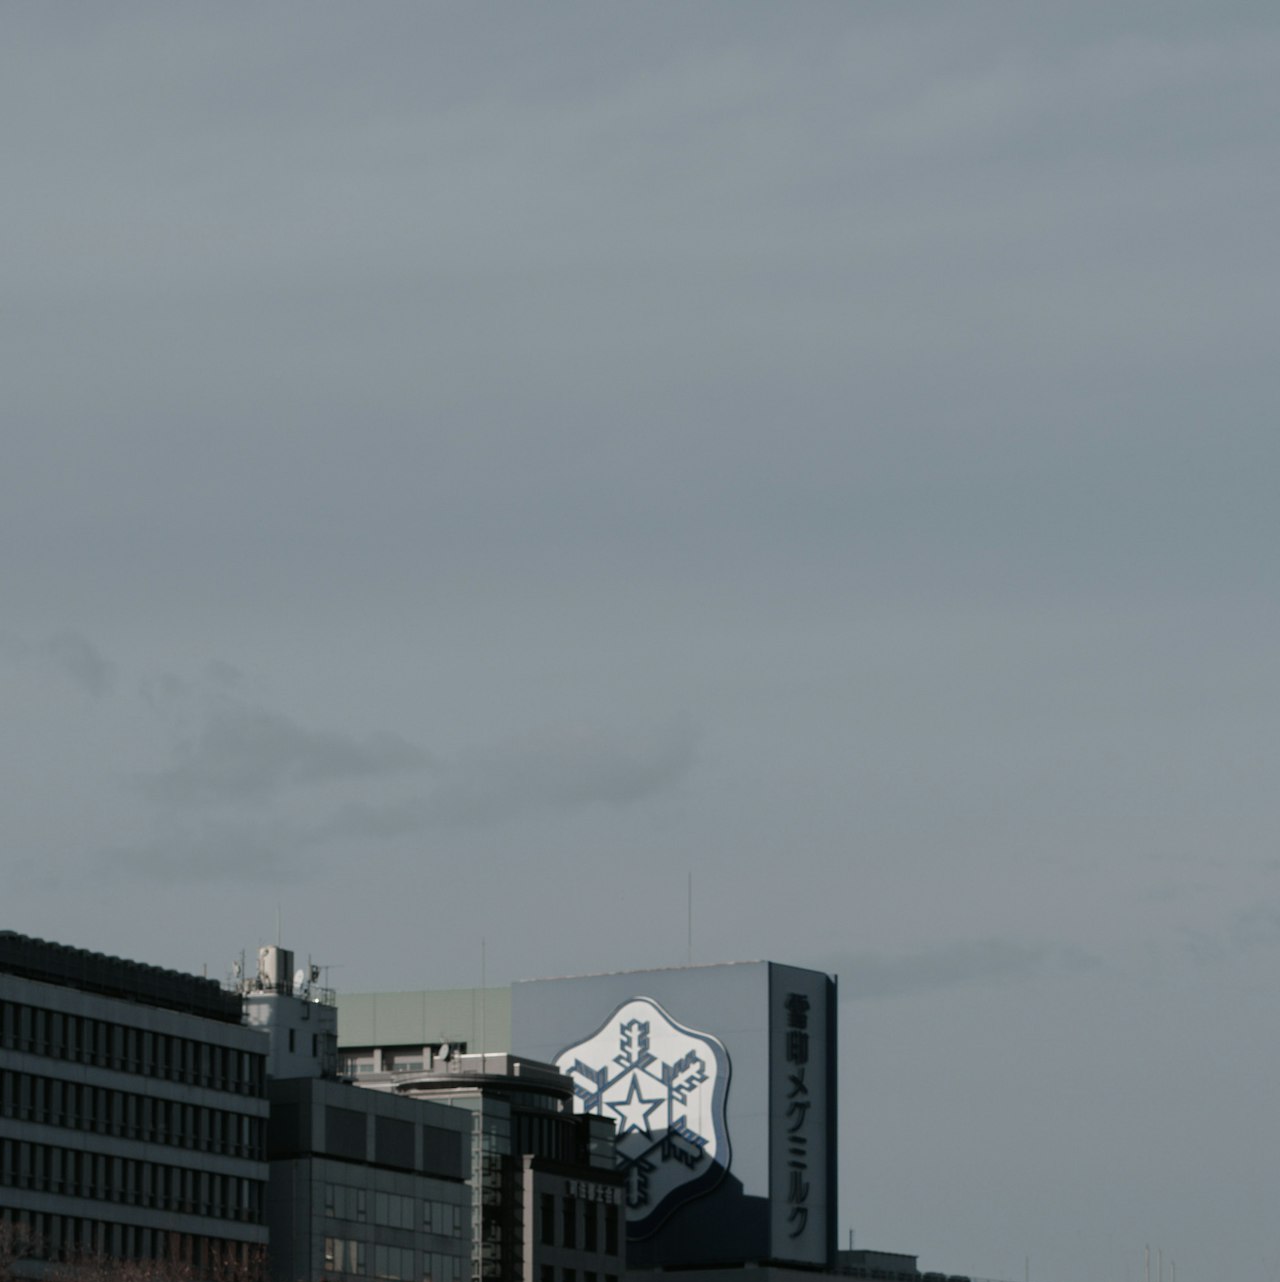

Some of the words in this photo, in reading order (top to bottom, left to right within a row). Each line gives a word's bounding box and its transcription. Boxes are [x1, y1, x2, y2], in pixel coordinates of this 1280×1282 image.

[784, 992, 811, 1239] 雪印メグミルク
